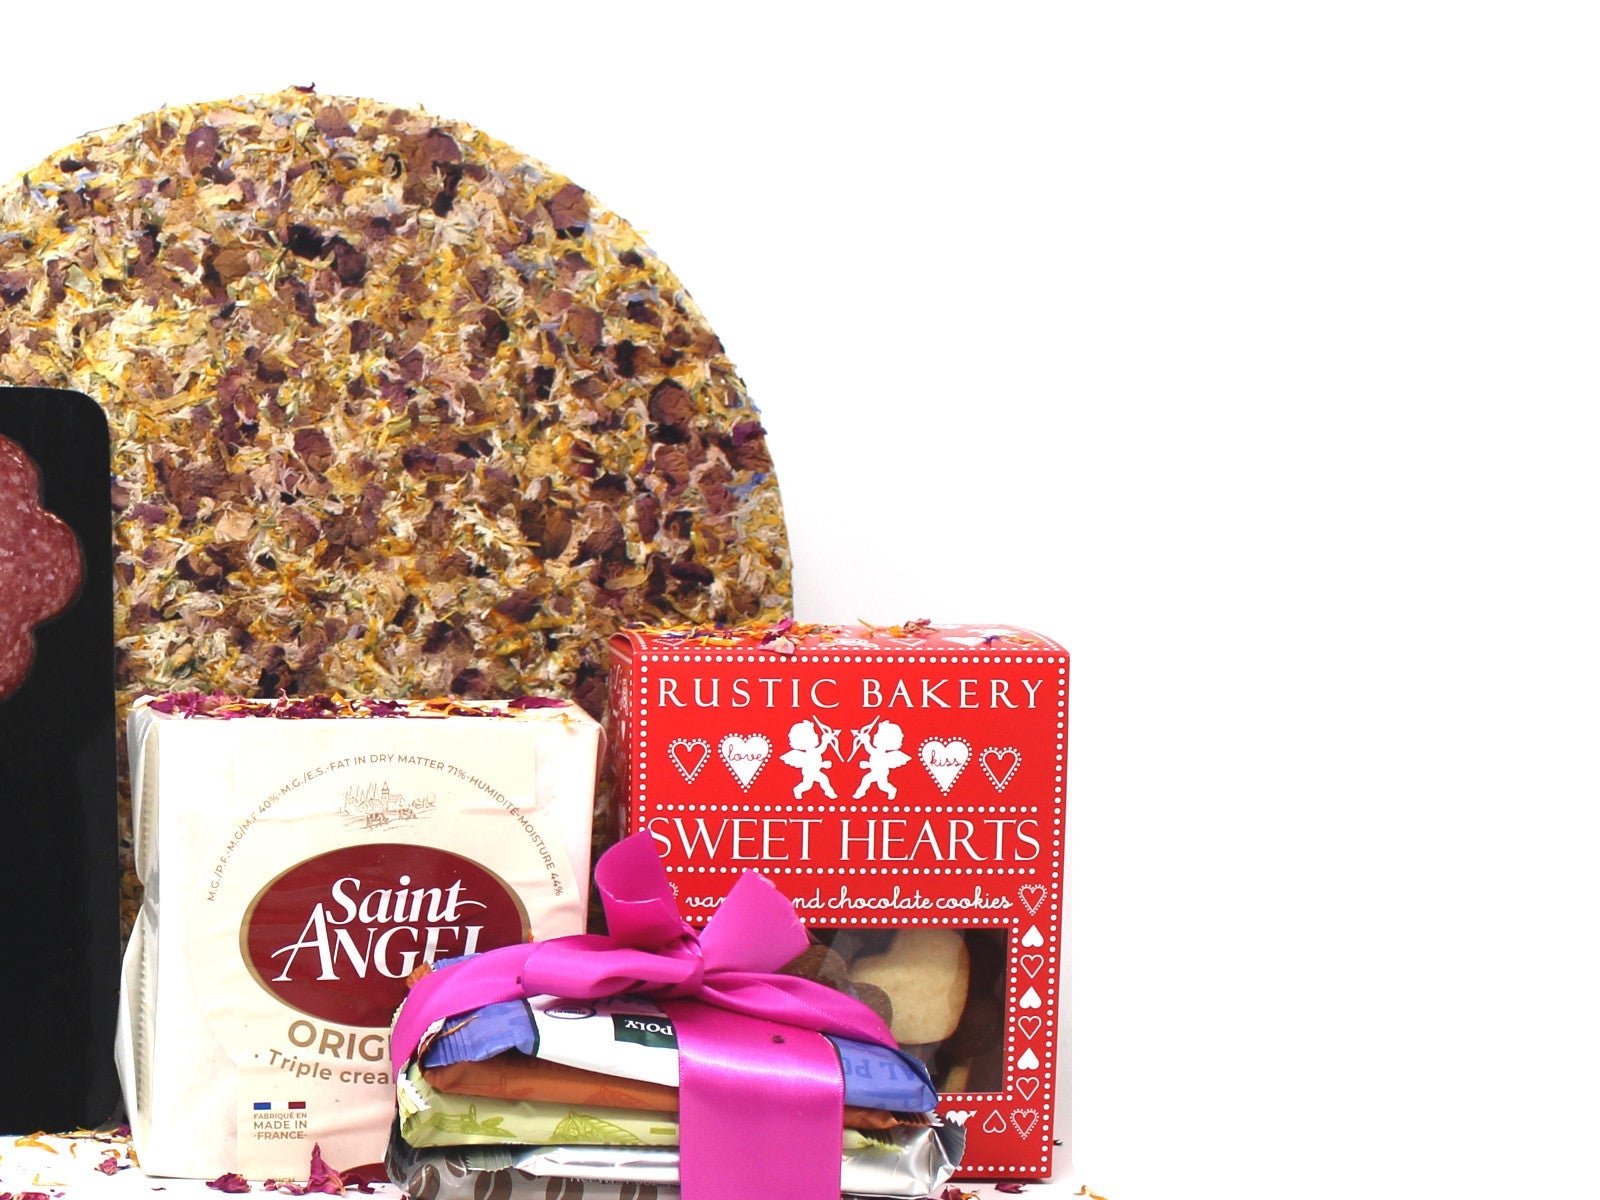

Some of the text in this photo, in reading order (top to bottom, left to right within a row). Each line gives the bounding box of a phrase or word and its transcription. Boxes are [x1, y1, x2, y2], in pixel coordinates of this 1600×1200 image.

[658, 677, 840, 708] RUSTIC
[862, 678, 1043, 709] BAKERY
[727, 744, 764, 762] love
[930, 750, 962, 767] kiss
[354, 755, 366, 765] IN
[370, 754, 394, 763] DRY
[398, 755, 445, 771] MATTER
[551, 872, 564, 897] 44%
[647, 817, 1040, 861] SWEET HEARTS
[326, 875, 487, 925] Saint
[828, 886, 933, 909] chocolate
[936, 886, 1013, 909] cookies
[288, 1020, 391, 1062] ORIG
[625, 1020, 673, 1036] POLY
[269, 1049, 396, 1085] Triple crea
[254, 1120, 307, 1130] MADE IN
